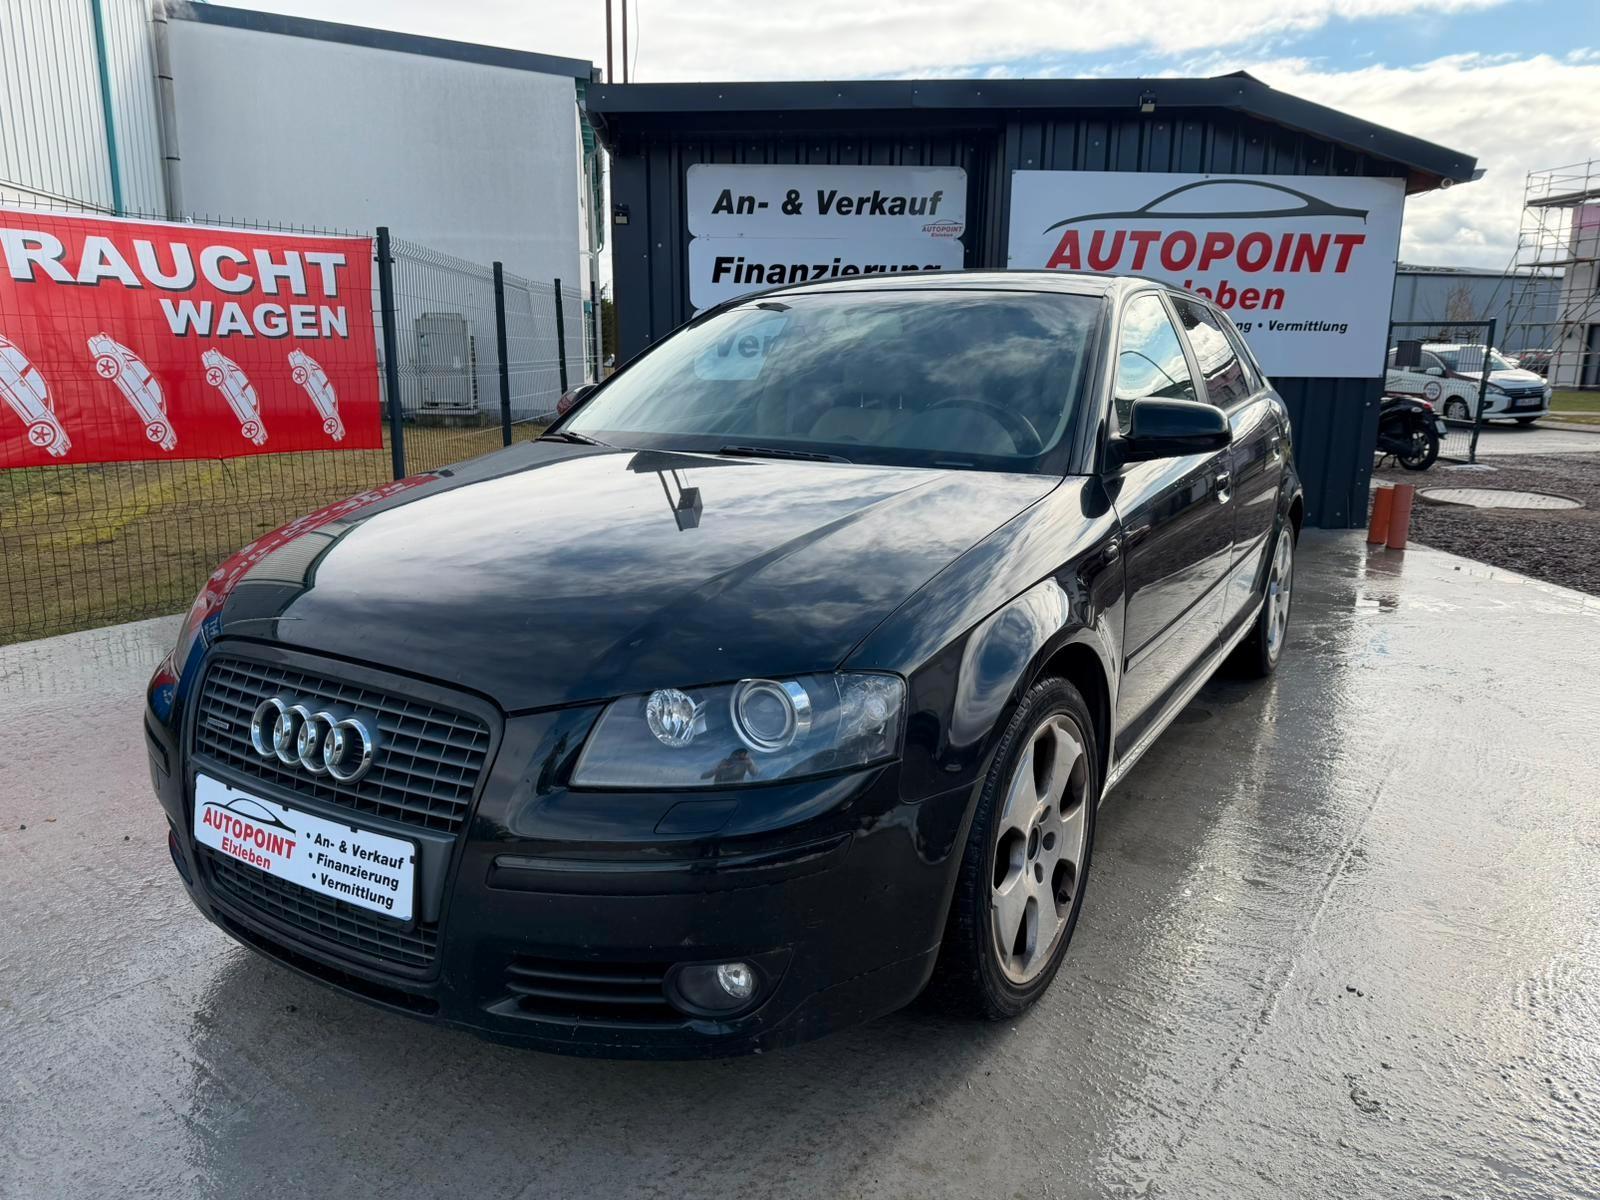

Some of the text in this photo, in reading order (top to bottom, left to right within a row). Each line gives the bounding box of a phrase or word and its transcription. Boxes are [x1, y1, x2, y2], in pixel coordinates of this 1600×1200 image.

[711, 188, 944, 216] An- & Verkauf
[0, 227, 348, 298] RAUCHT
[711, 256, 942, 284] Finanzie
[1045, 229, 1367, 274] AUTOPOINT
[159, 298, 349, 338] WAGEN
[1268, 319, 1349, 334] Vermittlung
[203, 806, 297, 860] AUTOPOINT
[314, 833, 404, 870] An- & Verkauf
[222, 836, 271, 870] Elxleben
[316, 852, 399, 892] Finanzierung
[321, 872, 394, 910] Vermittlung
